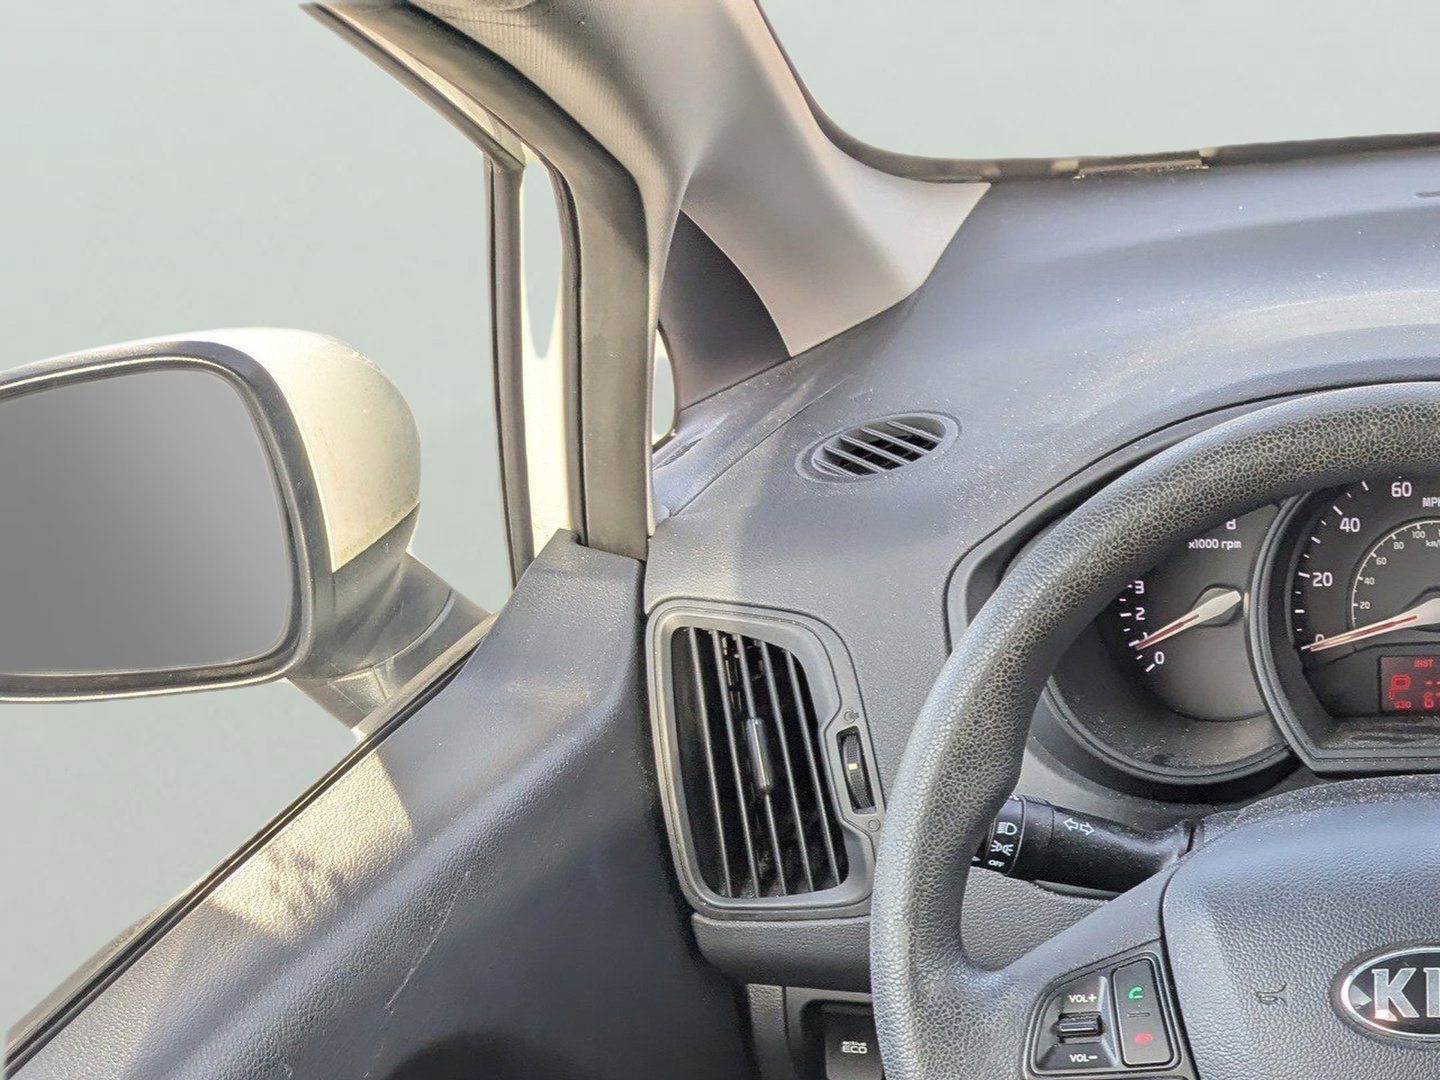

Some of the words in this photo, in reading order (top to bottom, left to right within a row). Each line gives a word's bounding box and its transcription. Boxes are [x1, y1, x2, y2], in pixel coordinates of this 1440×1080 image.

[1391, 482, 1412, 497] 60
[1339, 518, 1361, 533] 40
[1412, 531, 1426, 539] 100
[1188, 538, 1219, 549] x1000
[1221, 540, 1242, 550] rpm
[1393, 542, 1405, 550] 80
[1376, 557, 1387, 566] 60
[1312, 572, 1333, 587] 20
[1364, 577, 1375, 585] 40
[1134, 580, 1145, 594] 3
[1360, 601, 1371, 609] 20
[1135, 607, 1145, 620] 2
[1154, 651, 1165, 664] 0
[1389, 674, 1411, 698] P
[842, 1045, 868, 1054] ECO
